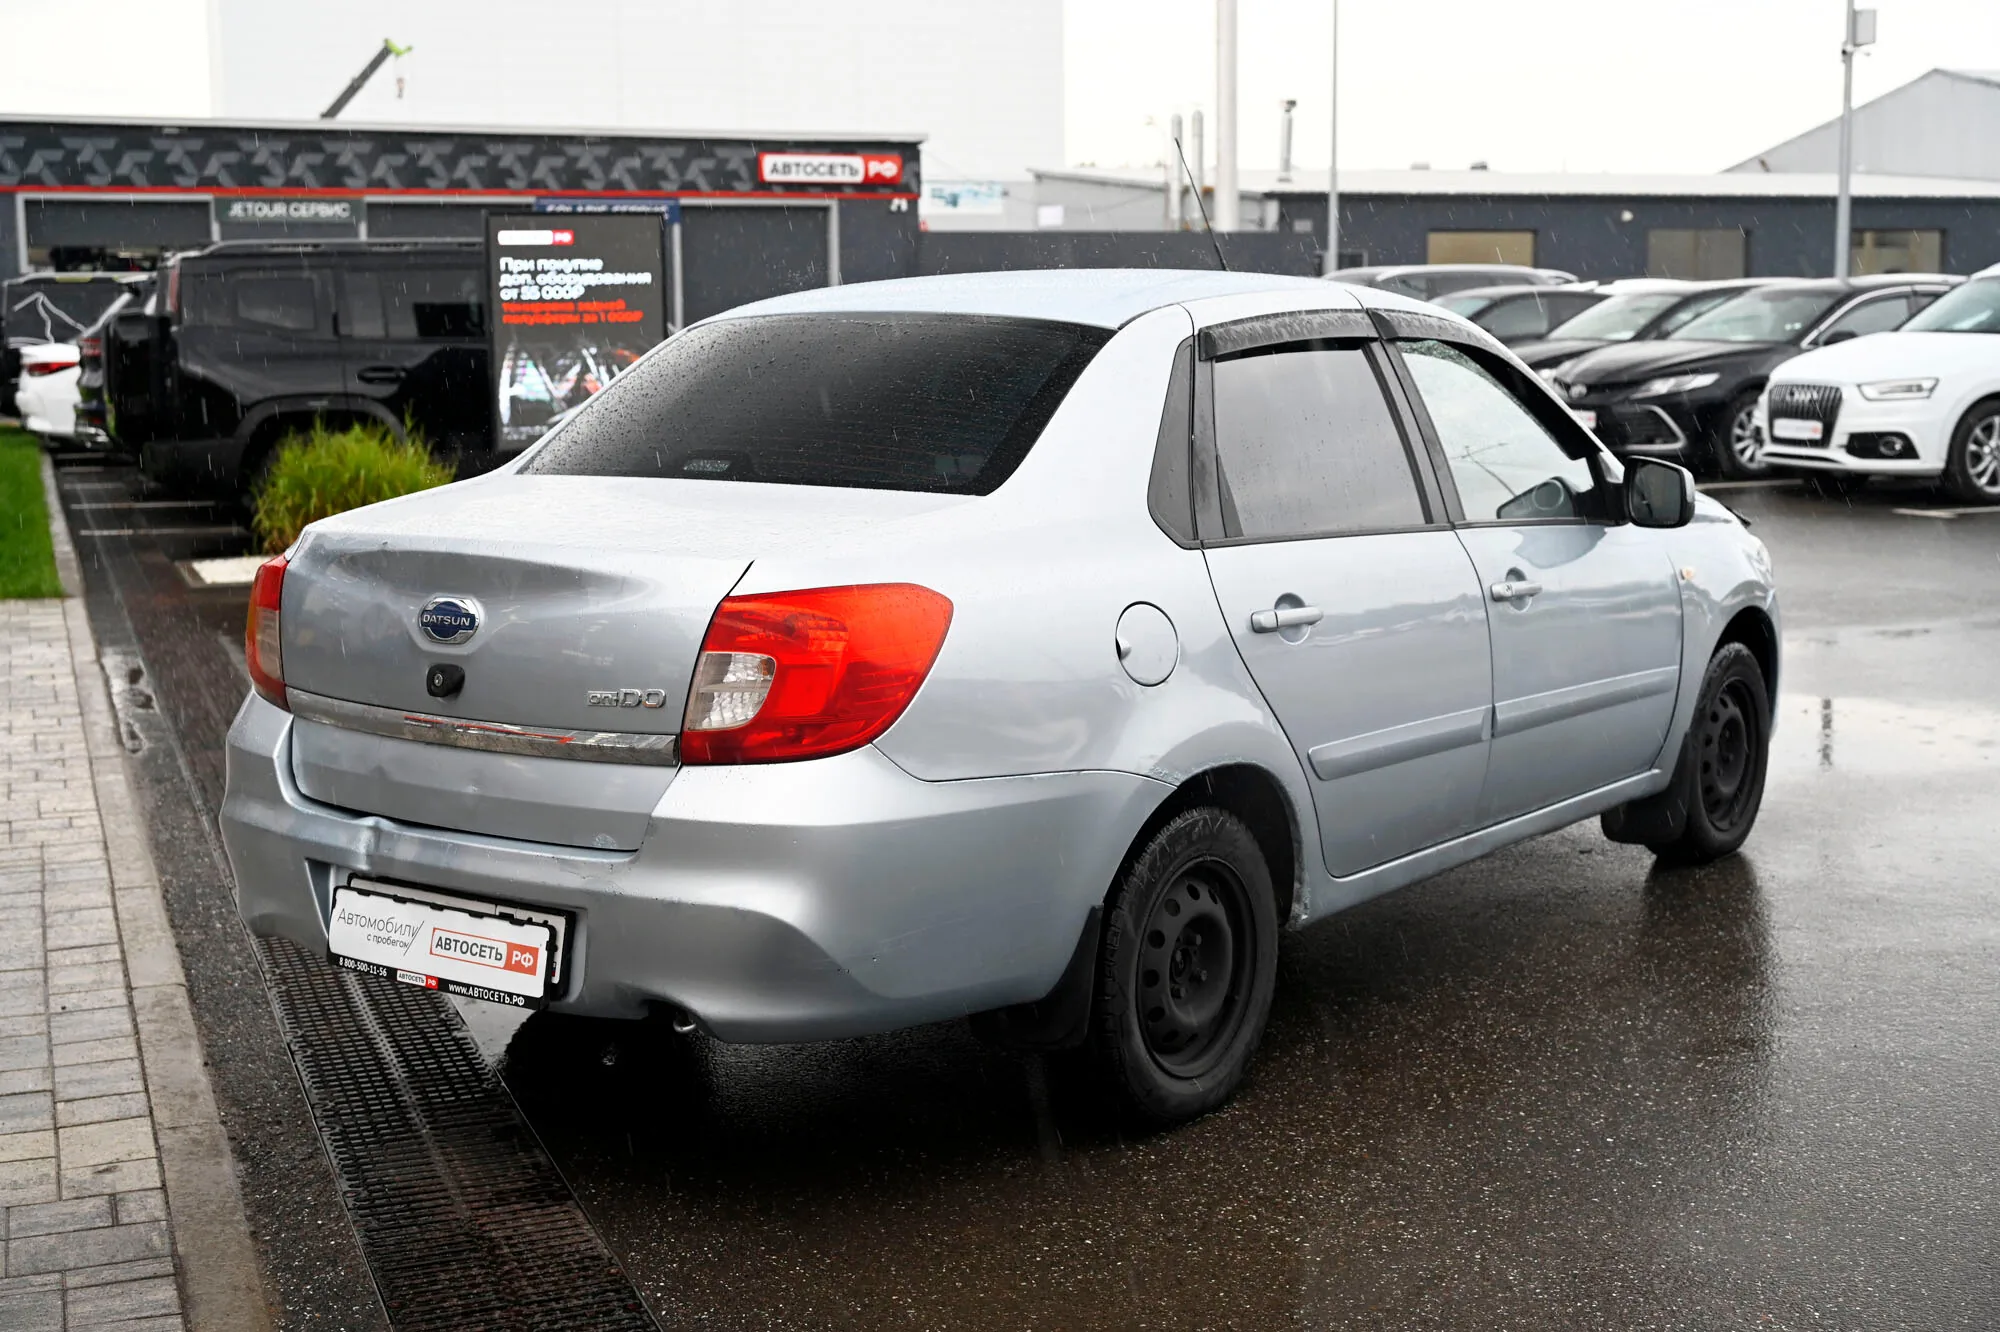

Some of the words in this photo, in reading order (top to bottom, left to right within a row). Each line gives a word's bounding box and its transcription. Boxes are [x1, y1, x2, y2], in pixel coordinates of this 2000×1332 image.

[769, 160, 860, 178] АВТОСЕТЬ
[867, 160, 898, 178] РФ
[228, 201, 287, 218] JETOUR
[288, 201, 351, 218] СЕРВИС
[499, 256, 535, 274] При
[499, 287, 519, 301] от
[423, 614, 471, 627] DATSUN
[366, 933, 372, 942] с
[372, 934, 411, 950] пробегом
[435, 936, 503, 962] АВТОСЕТЬ
[511, 950, 534, 968] РФ
[344, 959, 387, 976] 800-500-11-56
[398, 972, 425, 984] АВТОСЕТЬ
[427, 978, 437, 986] РФ
[448, 983, 525, 1006] www.АВТОСЕТЬ.РФ
